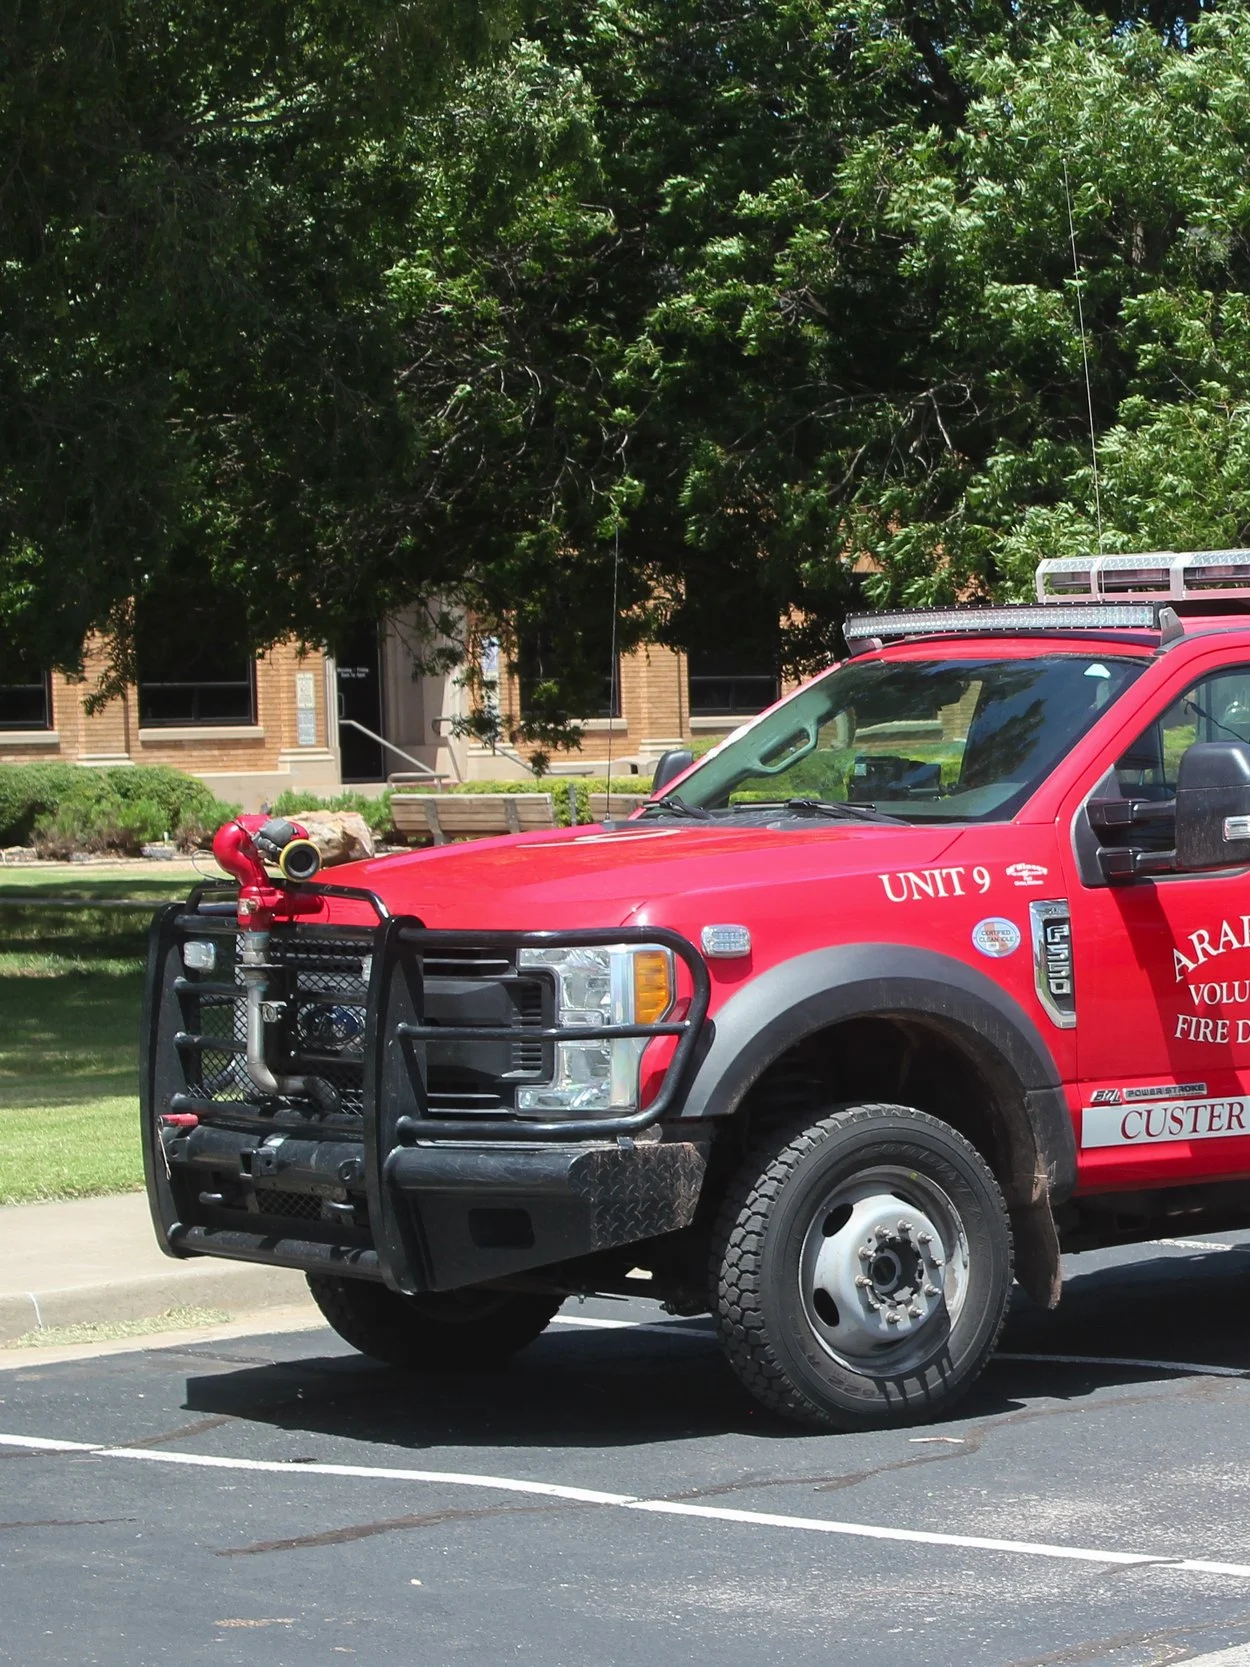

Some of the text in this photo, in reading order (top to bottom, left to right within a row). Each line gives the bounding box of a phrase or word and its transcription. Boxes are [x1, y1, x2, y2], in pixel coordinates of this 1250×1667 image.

[878, 866, 966, 902] UNIT
[973, 866, 991, 894] 9
[1174, 1013, 1230, 1044] FIRE
[1126, 1087, 1163, 1098] POWER
[1165, 1083, 1206, 1094] STROKE
[1120, 1101, 1246, 1140] CUSTER
